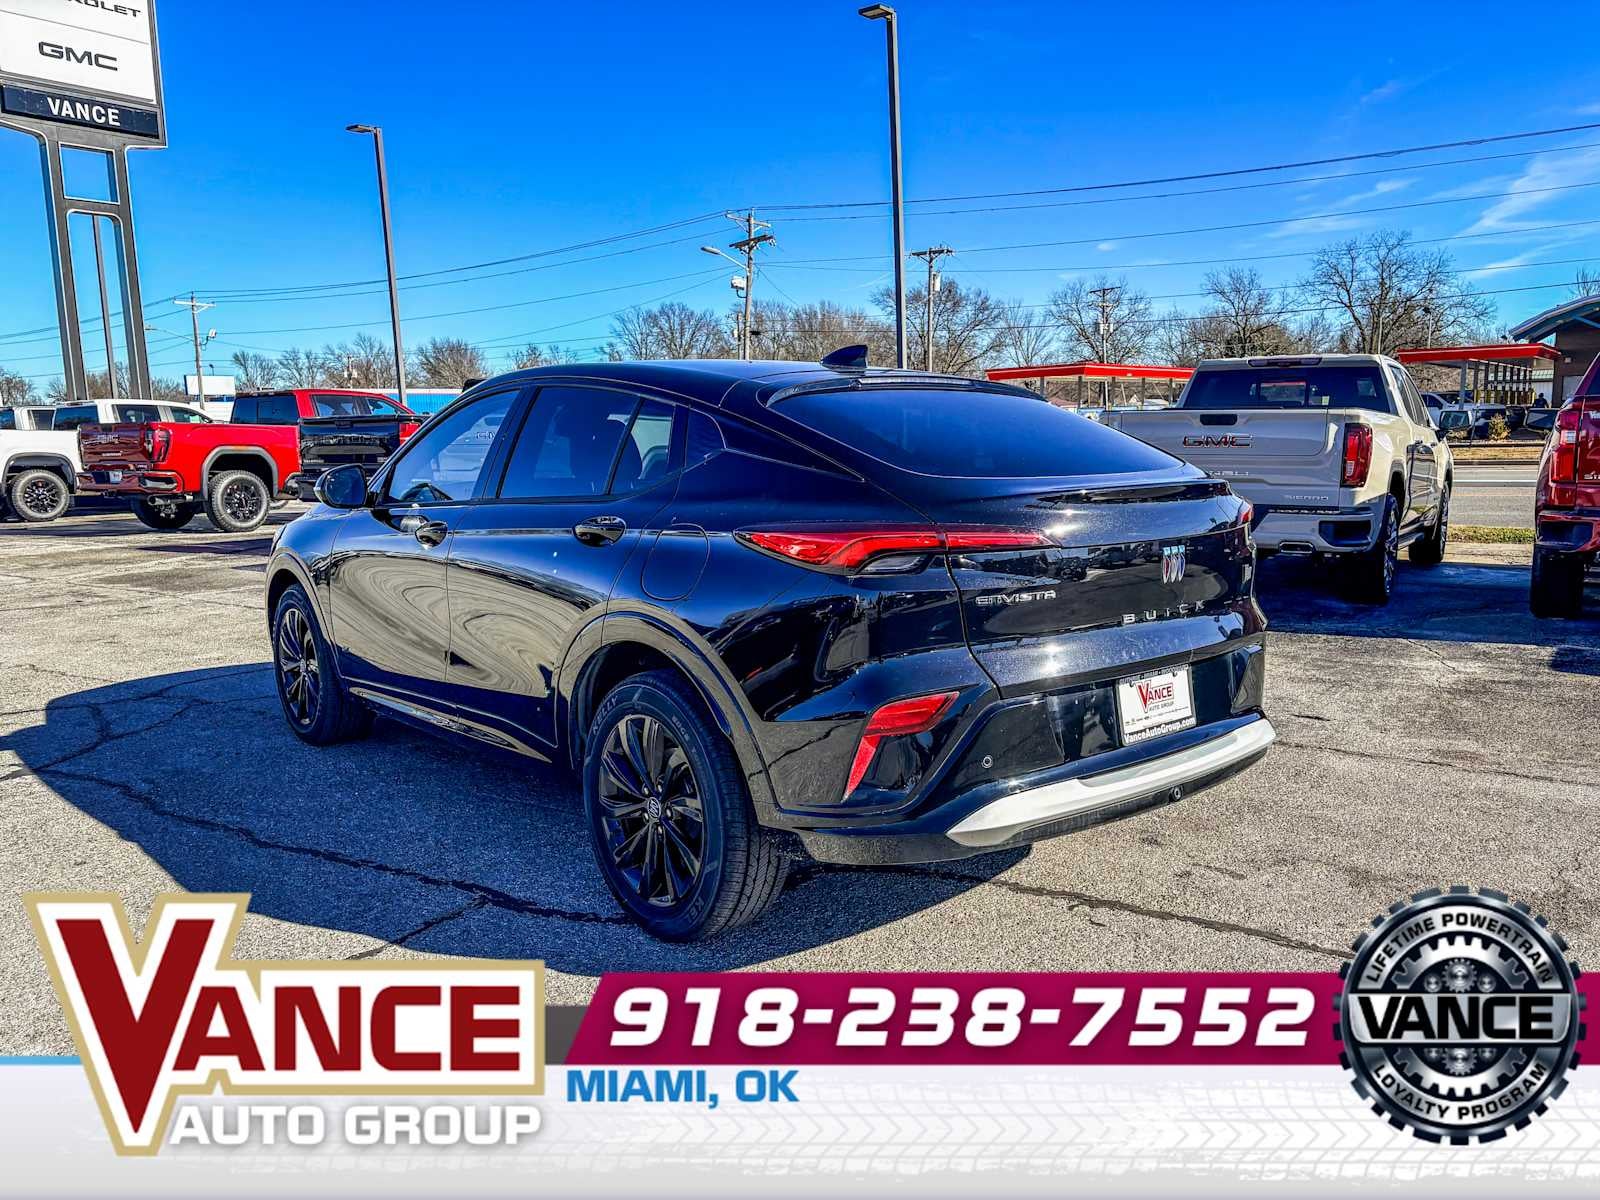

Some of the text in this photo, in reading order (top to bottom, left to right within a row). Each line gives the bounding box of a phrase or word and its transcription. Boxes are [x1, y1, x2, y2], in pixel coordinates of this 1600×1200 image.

[38, 41, 118, 71] GMC
[47, 97, 121, 126] VANCE
[1183, 432, 1253, 448] GMC
[975, 590, 1057, 605] ENVISTA
[1122, 599, 1206, 624] BUICK
[1137, 681, 1173, 711] VANCE
[1124, 717, 1197, 744] VanceAutoGroup.com
